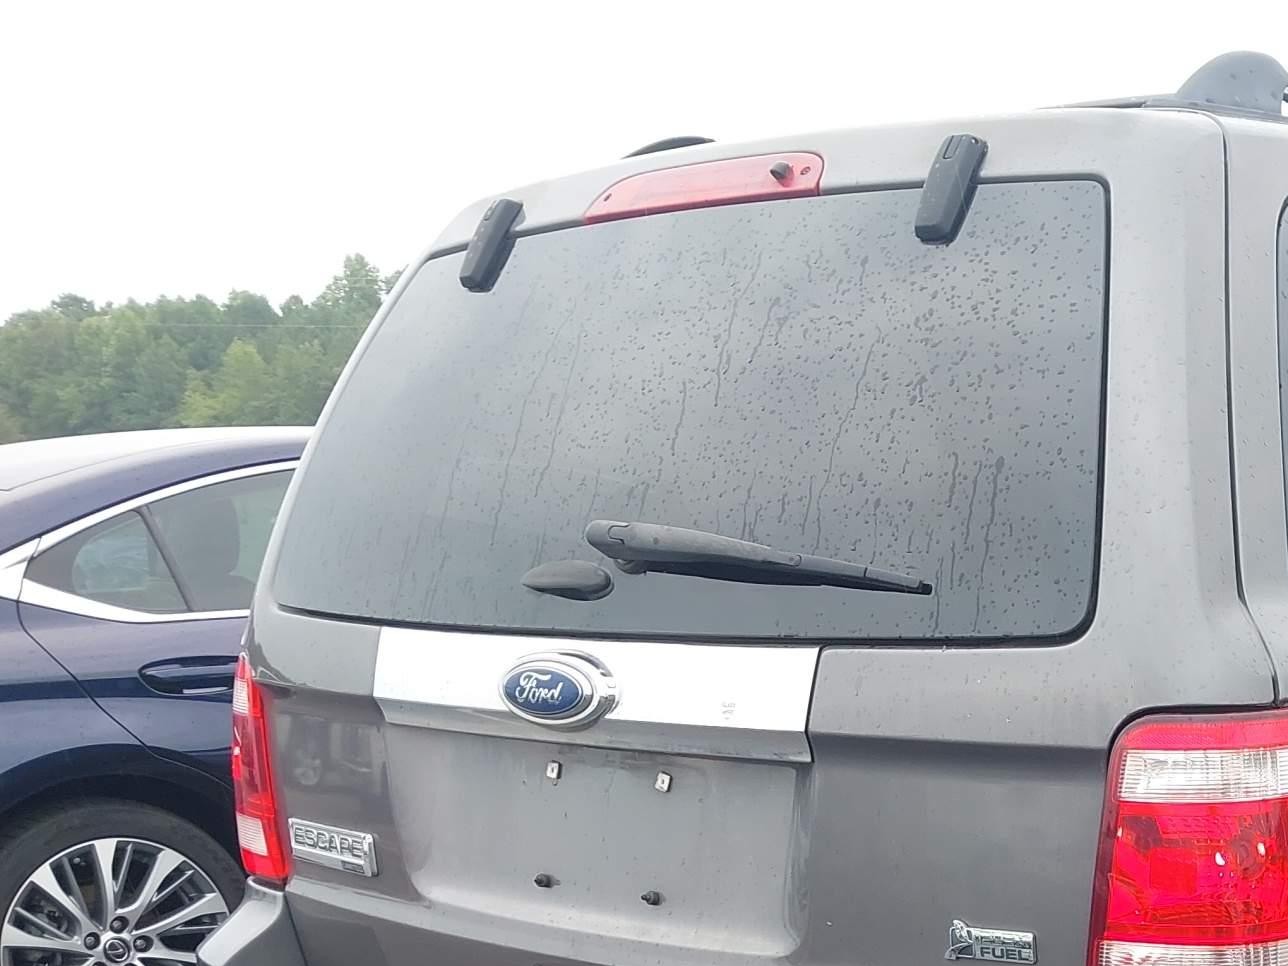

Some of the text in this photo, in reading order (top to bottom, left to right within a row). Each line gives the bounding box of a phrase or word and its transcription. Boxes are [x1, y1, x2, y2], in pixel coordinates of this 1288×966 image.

[515, 671, 564, 704] Ford
[294, 825, 364, 858] ESCAPE
[980, 946, 1030, 961] FUEL
